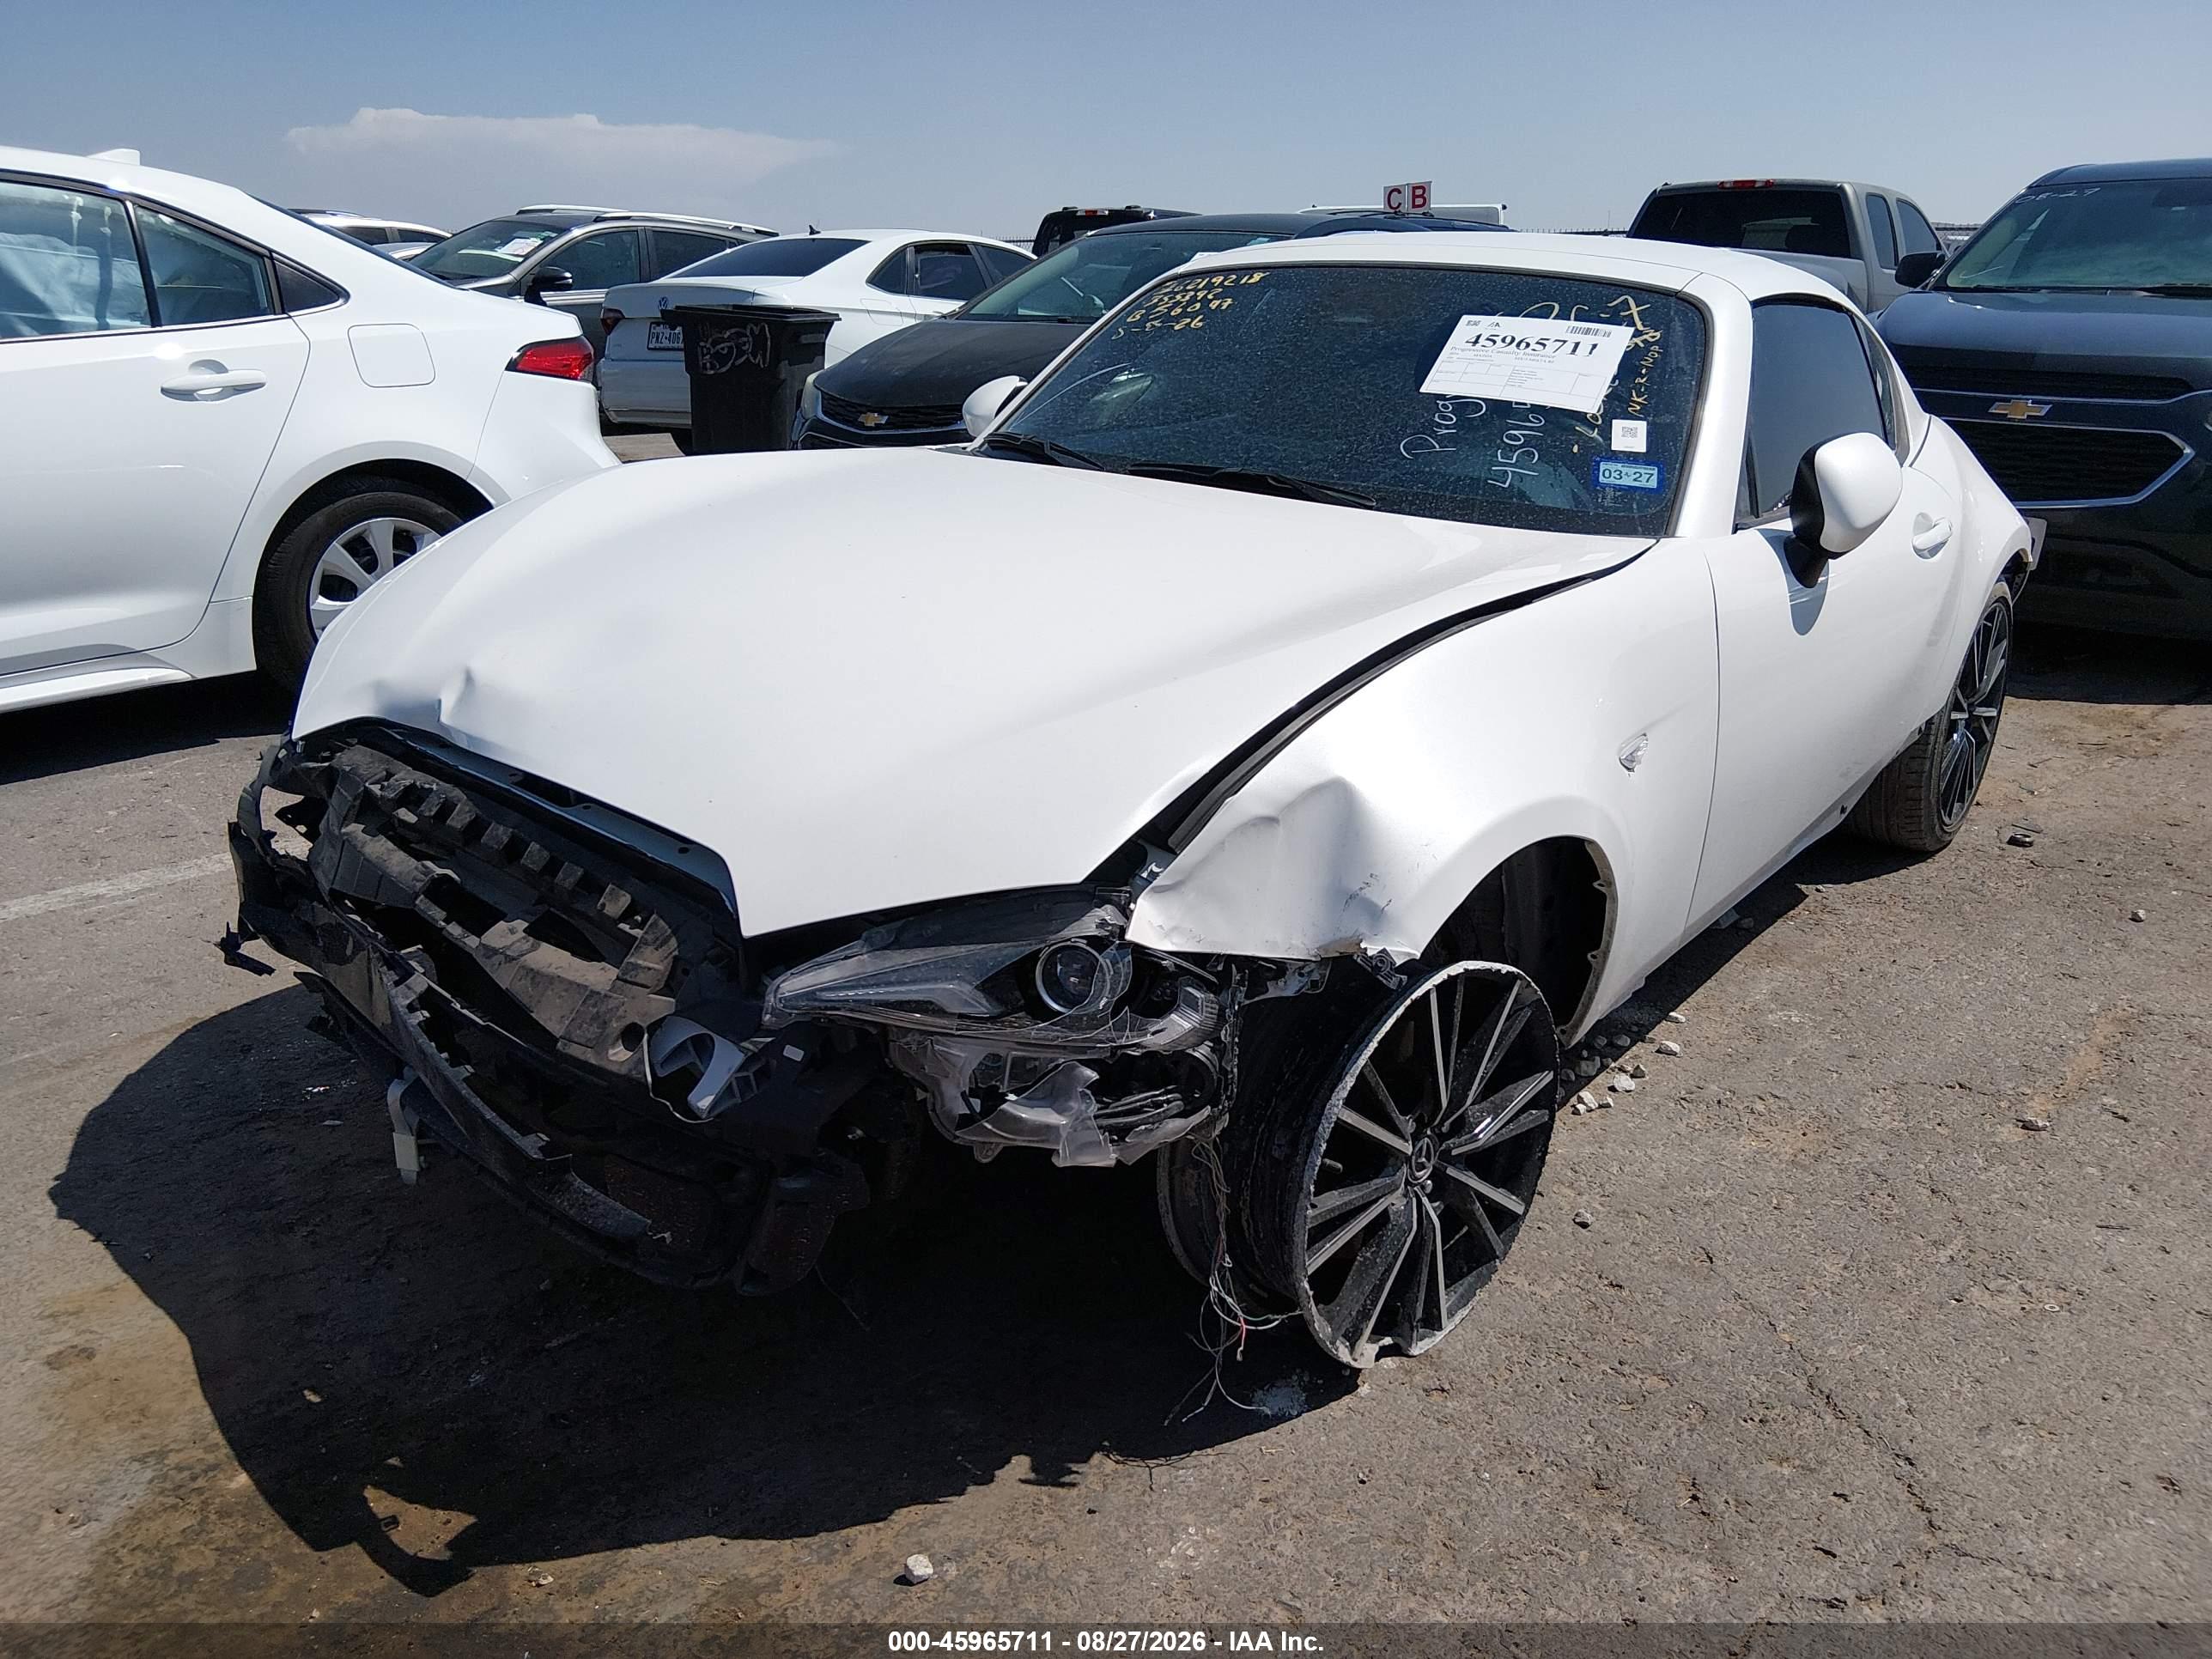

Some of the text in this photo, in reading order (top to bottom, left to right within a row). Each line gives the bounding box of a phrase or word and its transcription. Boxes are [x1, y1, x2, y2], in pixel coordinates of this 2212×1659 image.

[1387, 185, 1427, 210] C B
[1464, 332, 1599, 357] 45965711
[1601, 468, 1655, 483] 03 27
